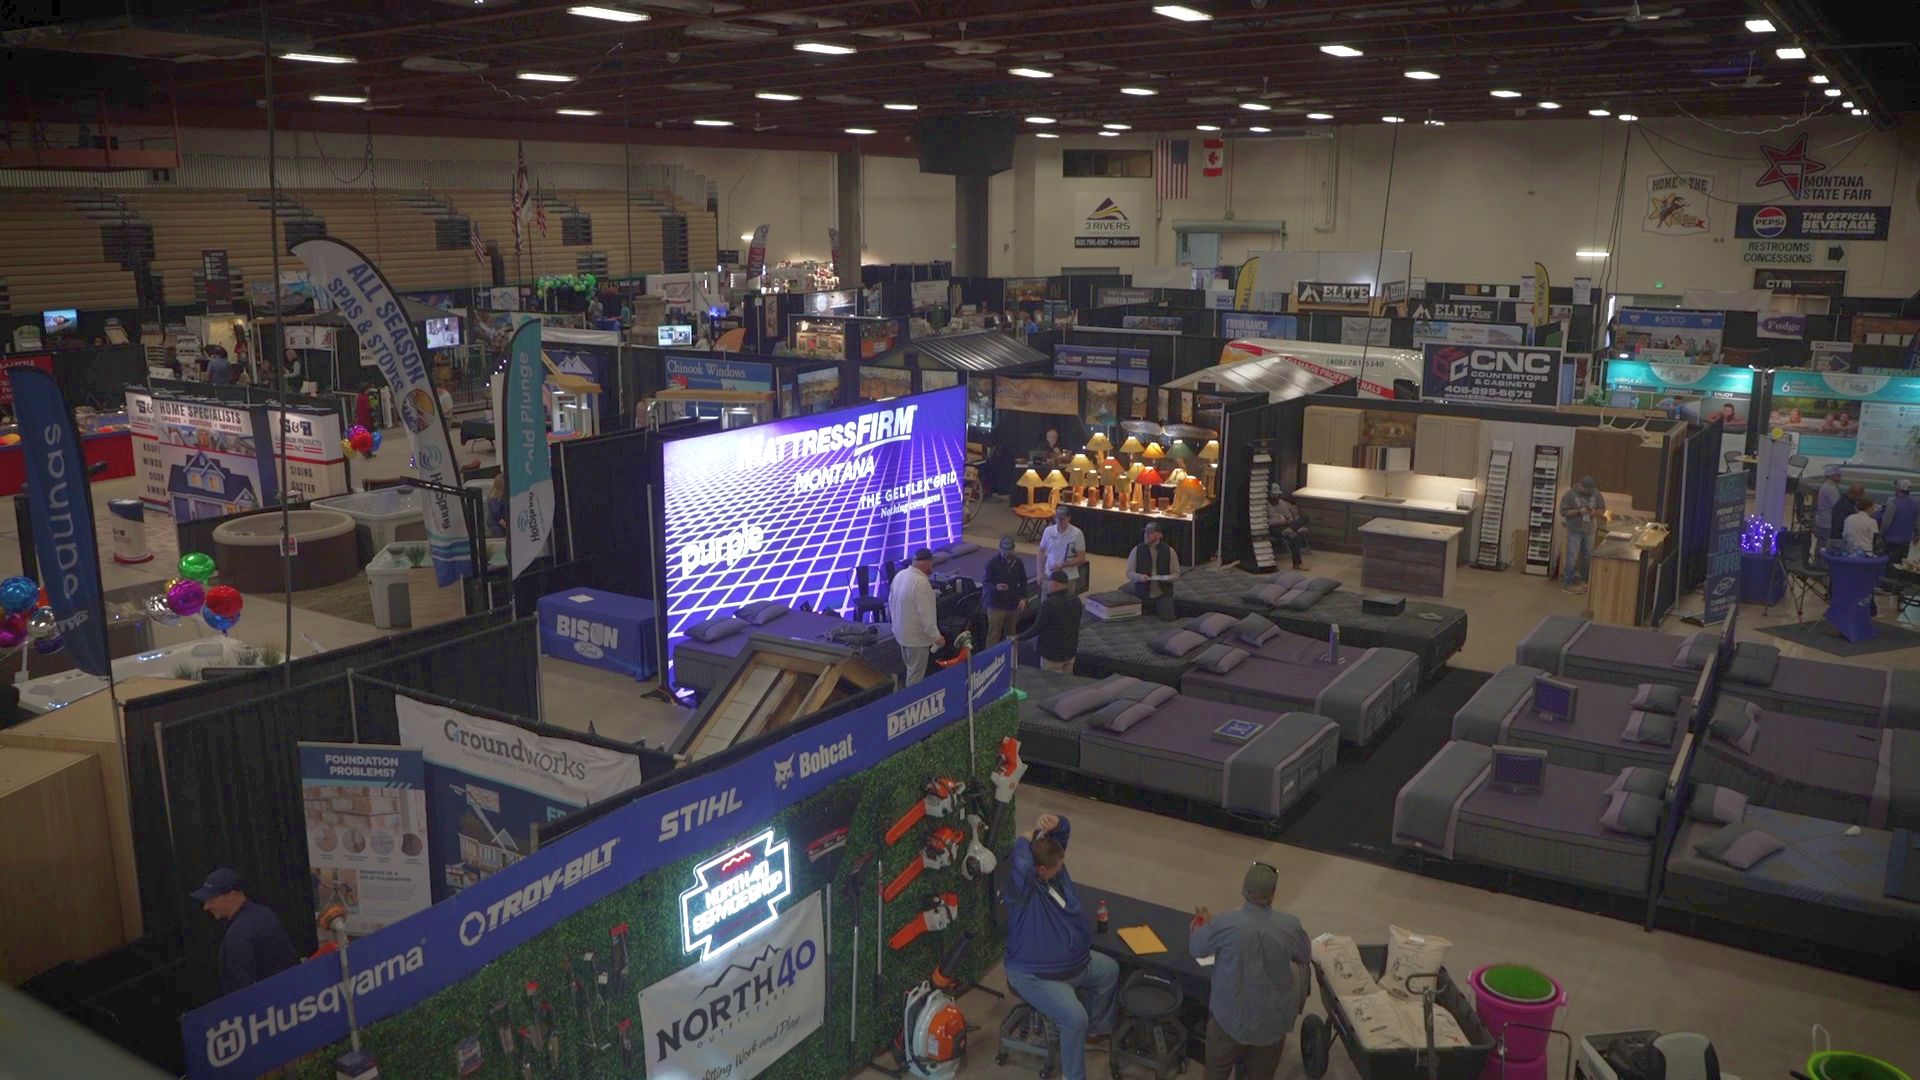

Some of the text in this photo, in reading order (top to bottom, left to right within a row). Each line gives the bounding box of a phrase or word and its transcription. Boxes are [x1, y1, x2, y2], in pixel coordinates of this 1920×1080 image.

[1689, 177, 1708, 191] THE
[1804, 175, 1864, 187] MONTANA
[1803, 188, 1872, 201] STATE FAIR
[1755, 217, 1785, 227] PEPSI
[1802, 212, 1877, 221] THE OFFICIAL
[1085, 222, 1130, 230] 3 RIVERS
[1801, 220, 1877, 230] BEVERAGE
[1749, 242, 1810, 253] RESTROOMS
[1744, 253, 1812, 264] CONCESSIONS
[346, 263, 381, 303] ALL
[1322, 285, 1369, 299] ELITE
[1434, 304, 1482, 318] ELITE
[1767, 320, 1801, 332] Fudge
[328, 278, 405, 393] SPAS & STOVES
[376, 300, 425, 384] SEASON
[667, 360, 746, 379] Chinook Windows
[1326, 358, 1346, 367] (406)
[1470, 350, 1551, 374] CNC
[1470, 371, 1548, 382] COUNTERTOPS
[1483, 379, 1536, 388] CABINETS
[519, 352, 535, 424] Plunge
[160, 402, 241, 424] HOME SPECIALISTS
[290, 465, 313, 478] SIDING
[795, 455, 875, 493] MONTANA
[860, 493, 881, 509] THE
[880, 503, 909, 518] Nothing
[680, 522, 764, 578] purple
[557, 614, 618, 649] BISON
[443, 719, 586, 780] Groundworks
[799, 733, 854, 779] Bobcat
[325, 755, 399, 767] FOUNDATION
[330, 766, 396, 778] PROBLEMS?
[659, 789, 743, 843] STIHL
[486, 838, 616, 932] TROY-BILT
[249, 945, 424, 1045] Husqvarna
[697, 987, 786, 1049] OUTFITTERS
[735, 1039, 757, 1068] Work
[758, 1026, 779, 1048] and
[780, 1015, 800, 1035] Play
